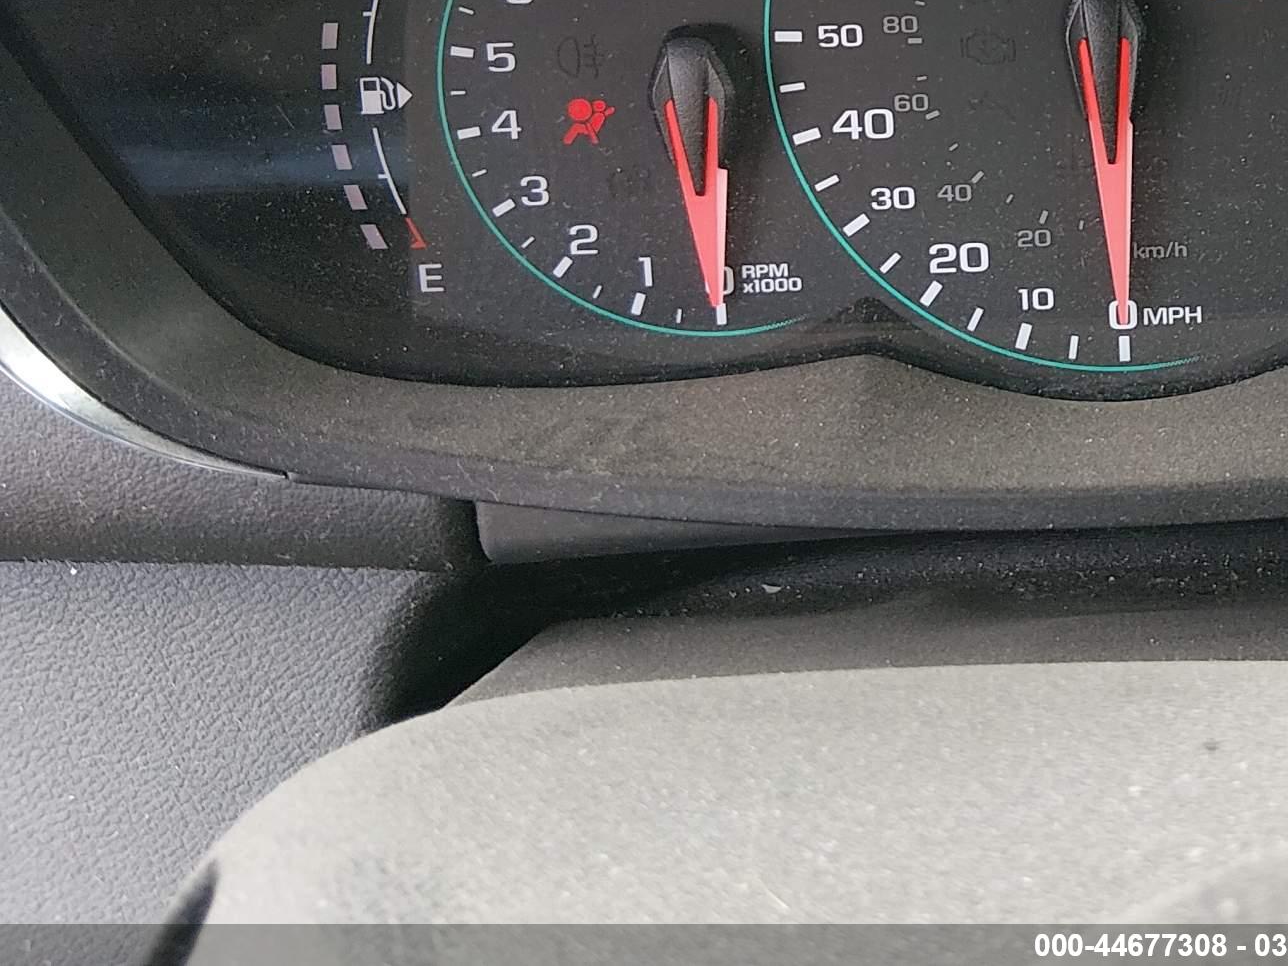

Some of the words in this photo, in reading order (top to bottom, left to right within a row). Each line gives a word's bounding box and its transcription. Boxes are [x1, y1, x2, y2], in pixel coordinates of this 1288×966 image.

[882, 15, 918, 34] 80
[817, 25, 863, 48] 50
[487, 43, 516, 72] 5
[893, 94, 929, 112] 60
[492, 111, 521, 139] 4
[833, 109, 894, 140] 40
[521, 176, 549, 206] 3
[871, 187, 915, 210] 30
[937, 185, 972, 202] 40
[570, 225, 598, 254] 2
[1017, 230, 1052, 248] 20
[1133, 241, 1188, 259] km/h
[929, 243, 989, 274] 20
[419, 264, 444, 292] E
[638, 257, 653, 286] 1
[742, 263, 788, 278] RPM
[743, 277, 802, 293] x1000
[1019, 288, 1054, 311] 10
[1109, 300, 1137, 329] 0
[1143, 306, 1202, 325] MPH
